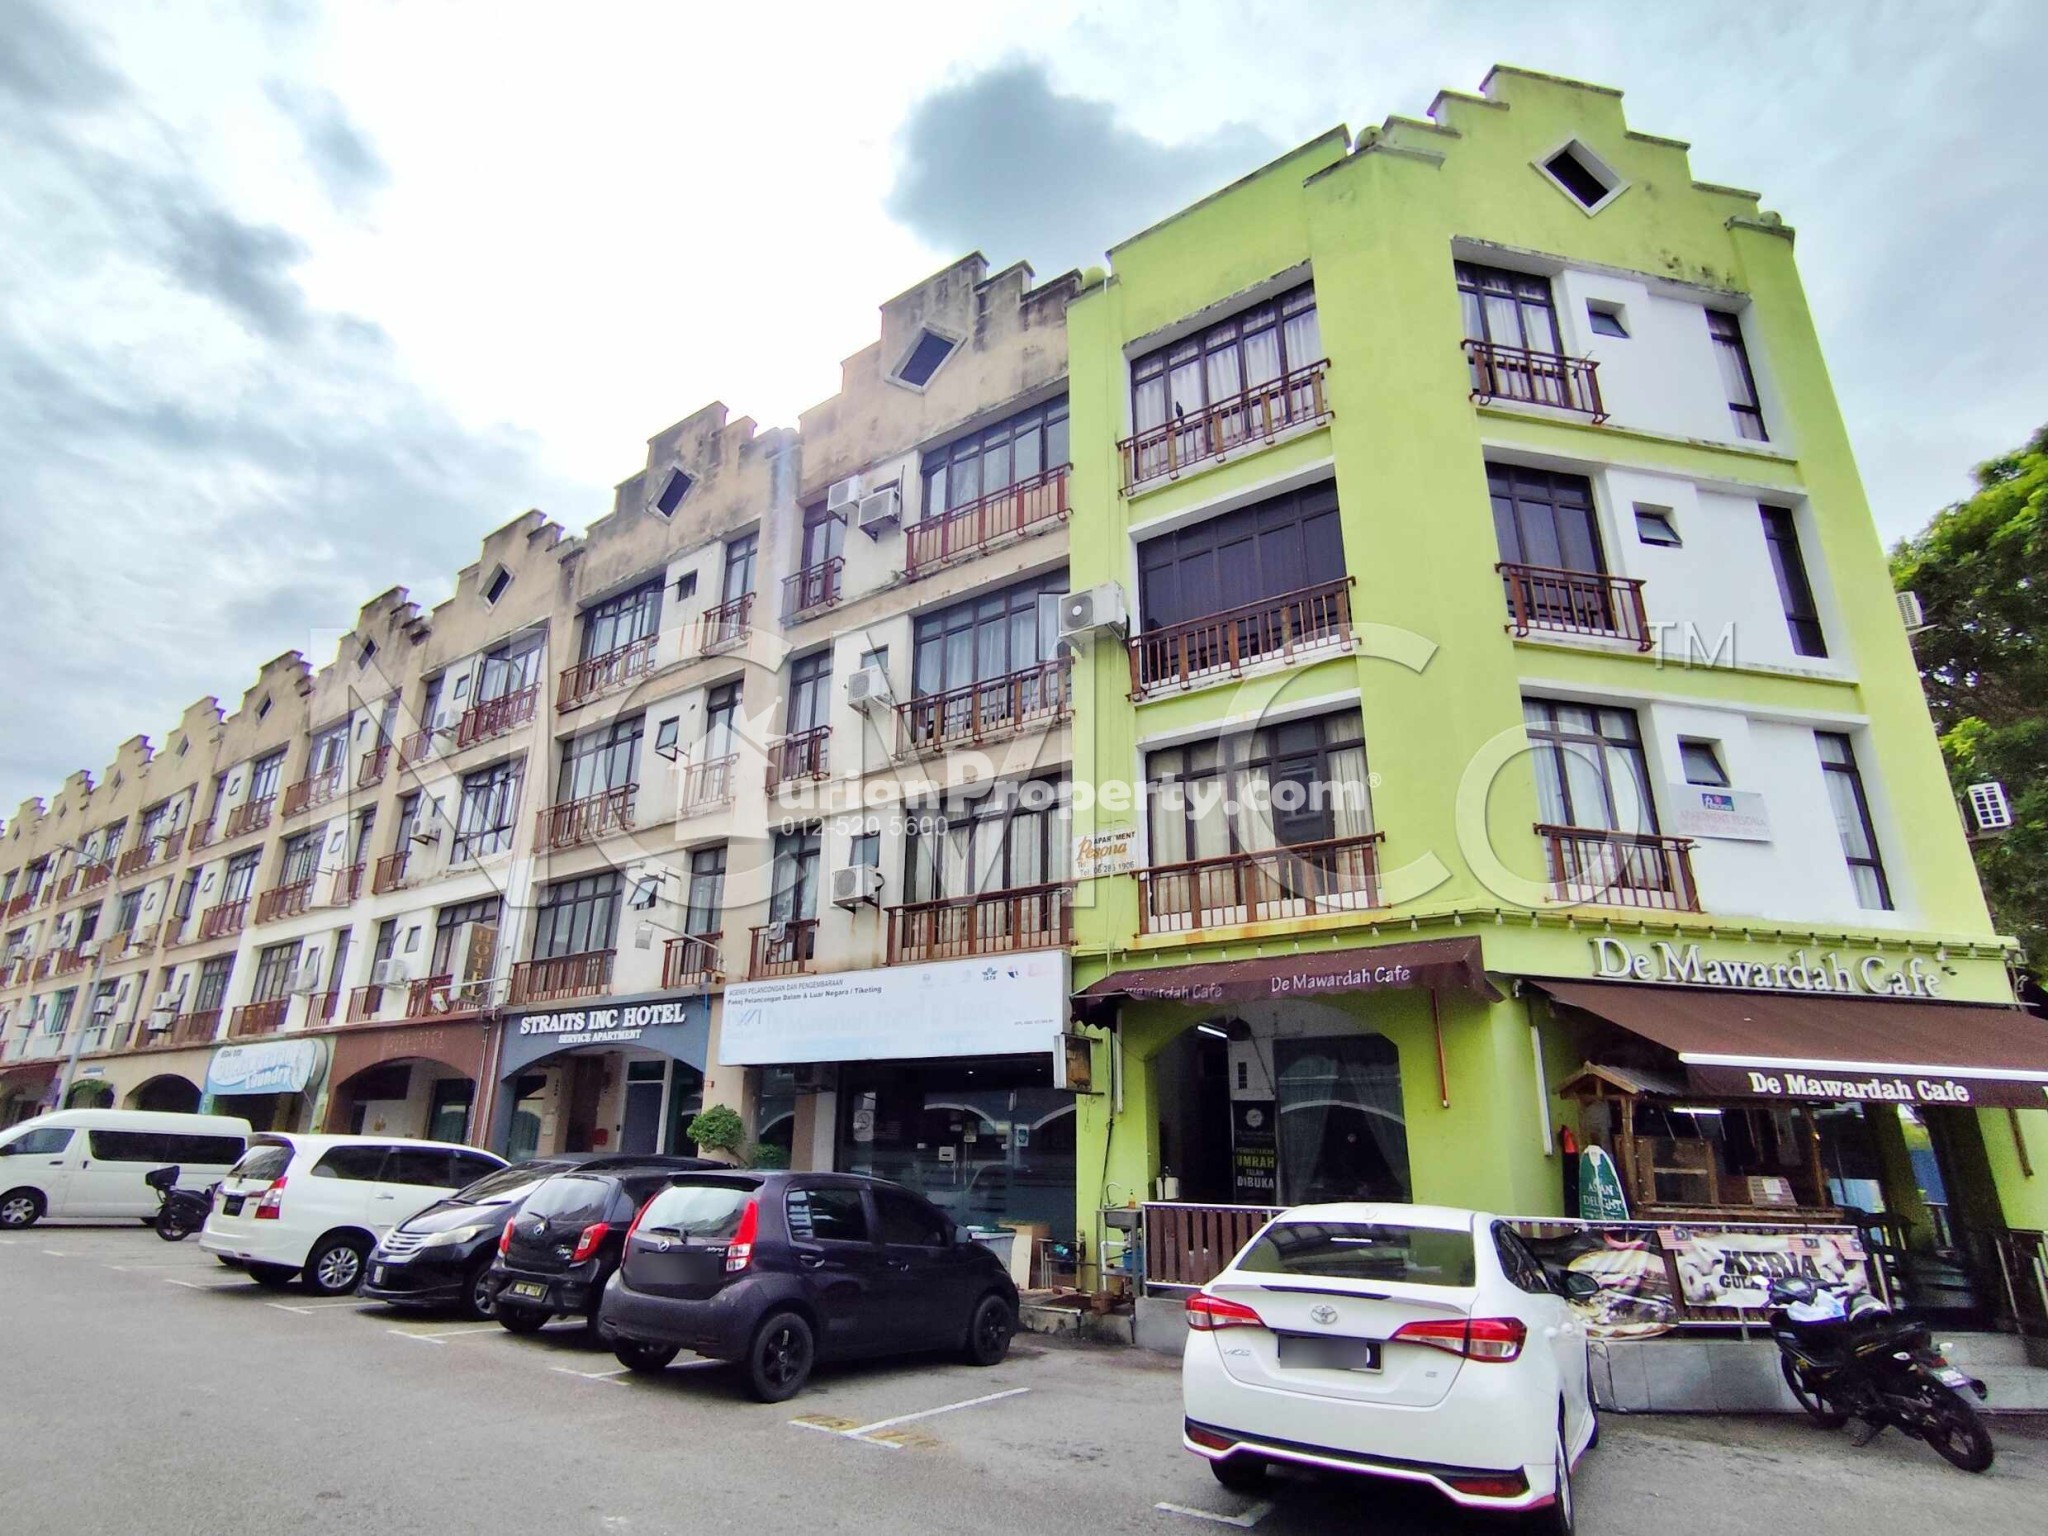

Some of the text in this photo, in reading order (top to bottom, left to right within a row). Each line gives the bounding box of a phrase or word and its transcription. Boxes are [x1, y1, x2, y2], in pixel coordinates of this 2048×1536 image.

[1077, 836, 1127, 860] Pesona
[1589, 937, 1941, 997] De Mawardah Cafe
[1271, 965, 1411, 992] De Mawardah Cafe
[809, 991, 824, 999] Luar
[825, 988, 849, 999] Negara
[854, 985, 882, 996] Tiketing
[1192, 982, 1222, 999] Cafe
[520, 1003, 686, 1035] STRAITS INC HOTEL
[558, 1029, 642, 1044] SERVICE APARTMENT
[1748, 1072, 1970, 1102] De Mawardah Cafe
[1236, 1155, 1275, 1168] UMRAH
[1237, 1176, 1275, 1189] DIBUKA
